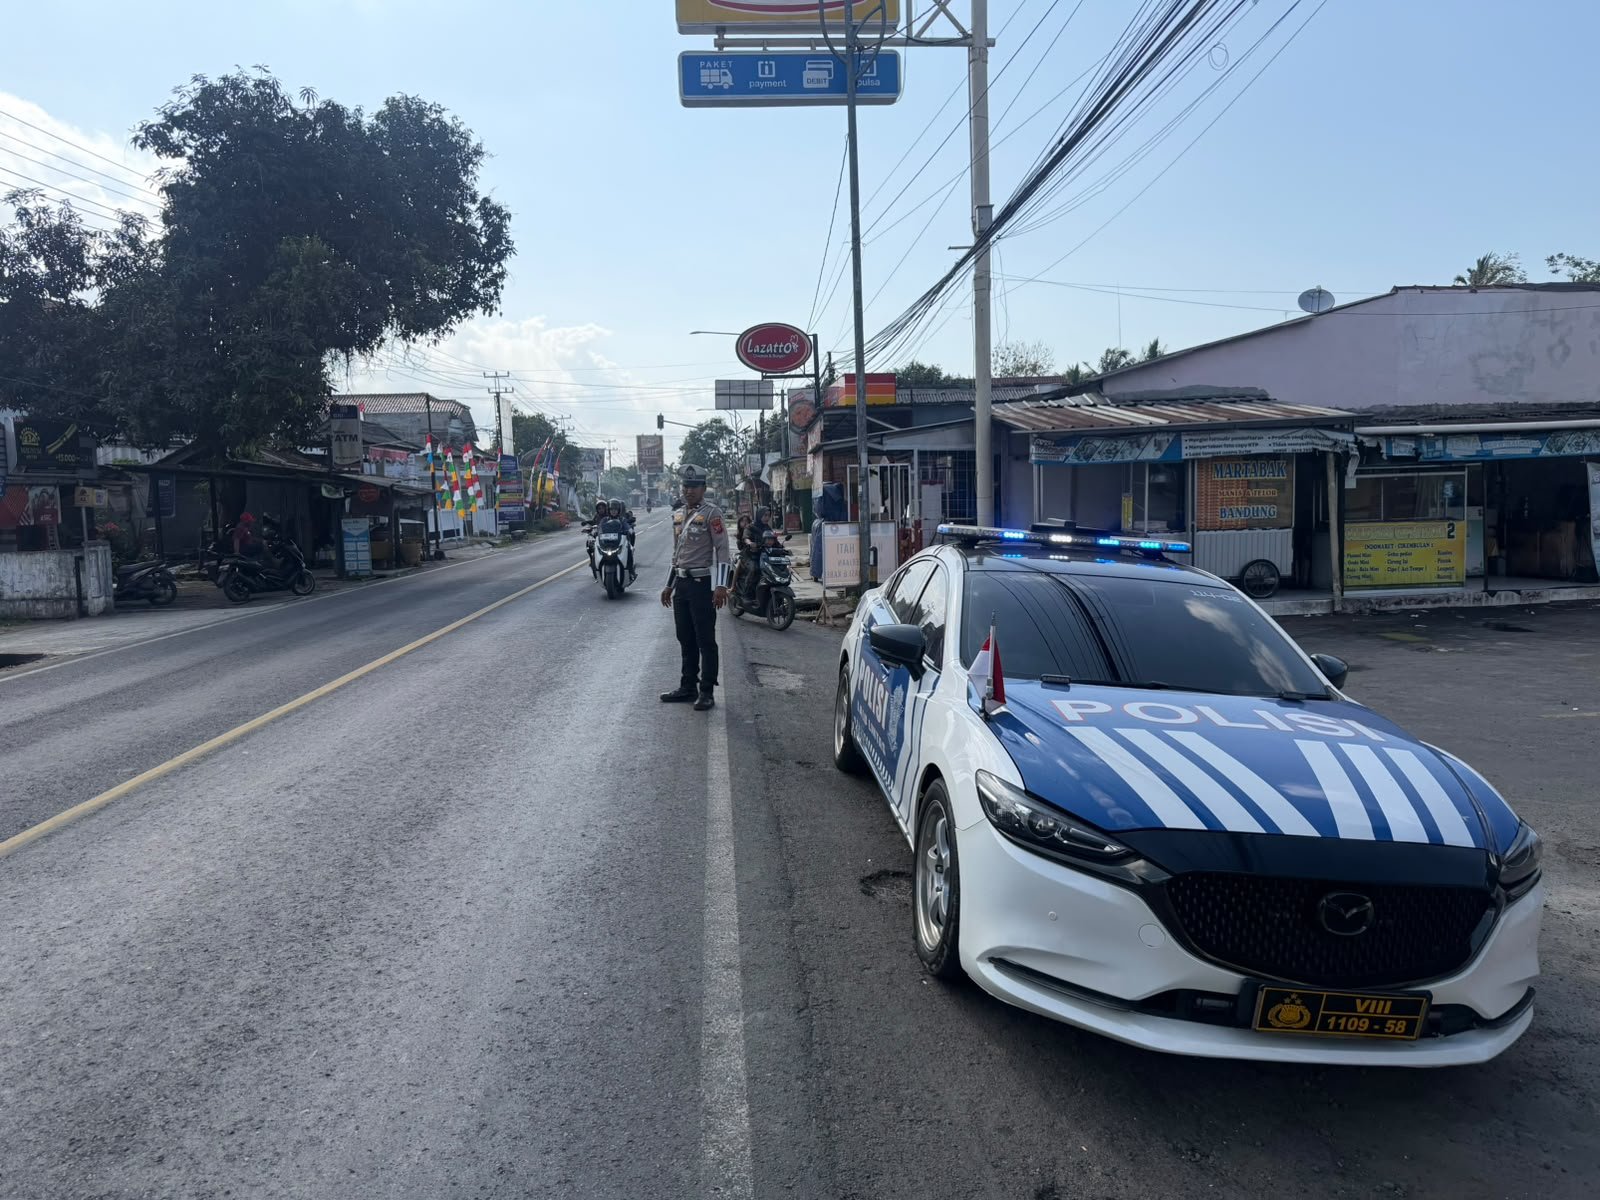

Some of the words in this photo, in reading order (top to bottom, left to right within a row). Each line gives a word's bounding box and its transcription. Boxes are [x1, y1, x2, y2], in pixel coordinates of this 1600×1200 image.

[749, 79, 787, 88] payment
[806, 77, 827, 85] DEBIT
[856, 77, 881, 87] pulsa
[747, 338, 793, 354] Lazatto
[334, 434, 359, 443] ATM
[1213, 461, 1286, 479] MARTABAK
[1219, 505, 1277, 519] BANDUNG
[1447, 522, 1456, 539] 2
[857, 657, 890, 731] POLISI
[1051, 699, 1386, 742] POLISI
[1355, 998, 1392, 1014] VIII
[1327, 1016, 1370, 1032] 1109
[1384, 1019, 1407, 1034] 58
